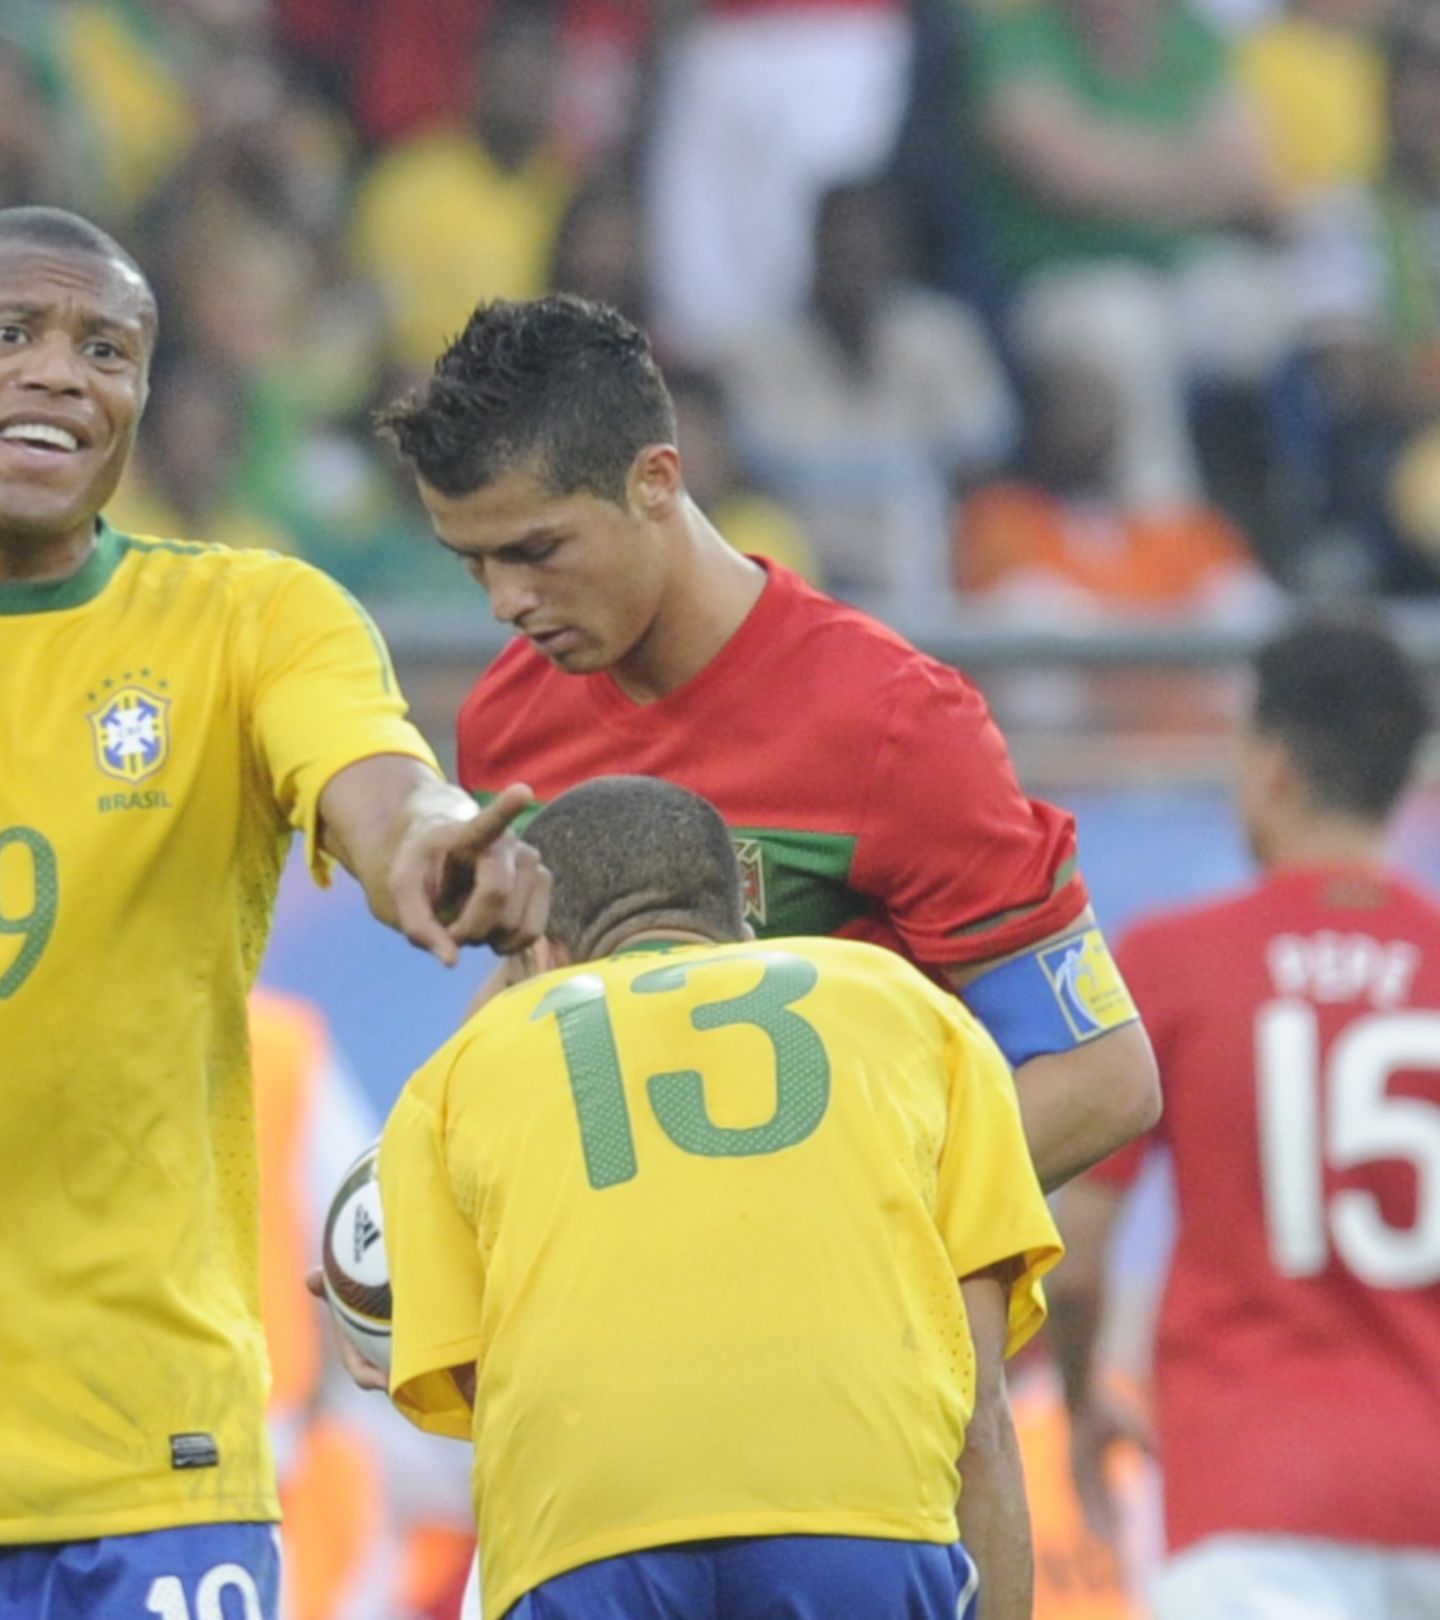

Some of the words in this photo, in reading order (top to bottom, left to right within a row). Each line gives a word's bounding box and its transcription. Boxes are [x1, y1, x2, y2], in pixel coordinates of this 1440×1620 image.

[98, 790, 171, 812] BRASIL
[529, 949, 831, 1190] 13
[1254, 1000, 1440, 1290] 15
